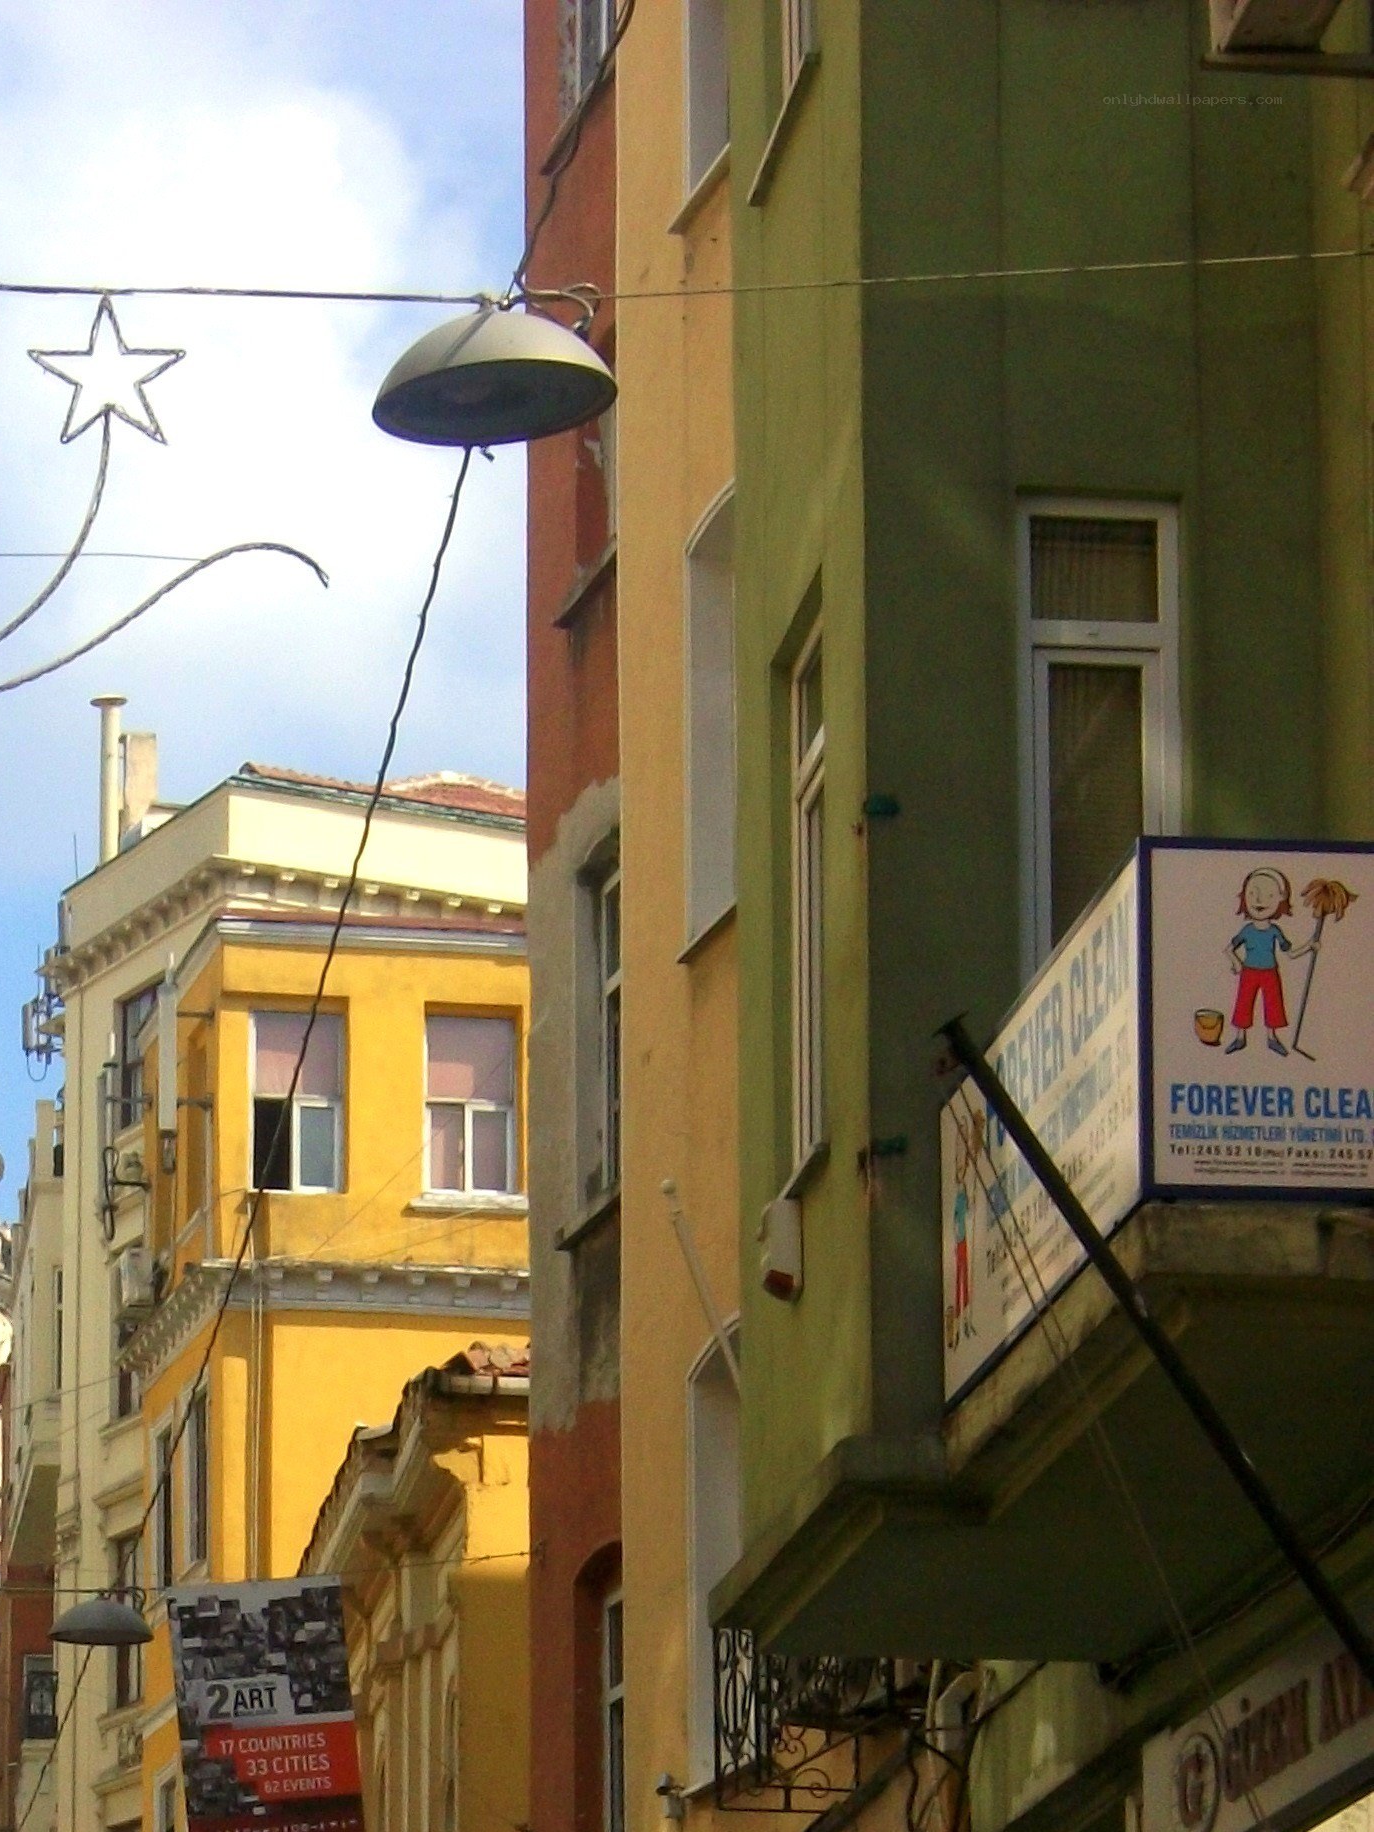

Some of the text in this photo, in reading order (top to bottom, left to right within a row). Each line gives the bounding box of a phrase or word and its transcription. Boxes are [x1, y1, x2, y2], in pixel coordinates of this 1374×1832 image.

[1170, 1083, 1374, 1119] FOREVER CLEA
[207, 1684, 276, 1718] 2 ART
[219, 1732, 326, 1755] 17 COUNTRIES
[246, 1753, 330, 1776] 33 CITIES
[283, 1776, 332, 1792] EVENTS
